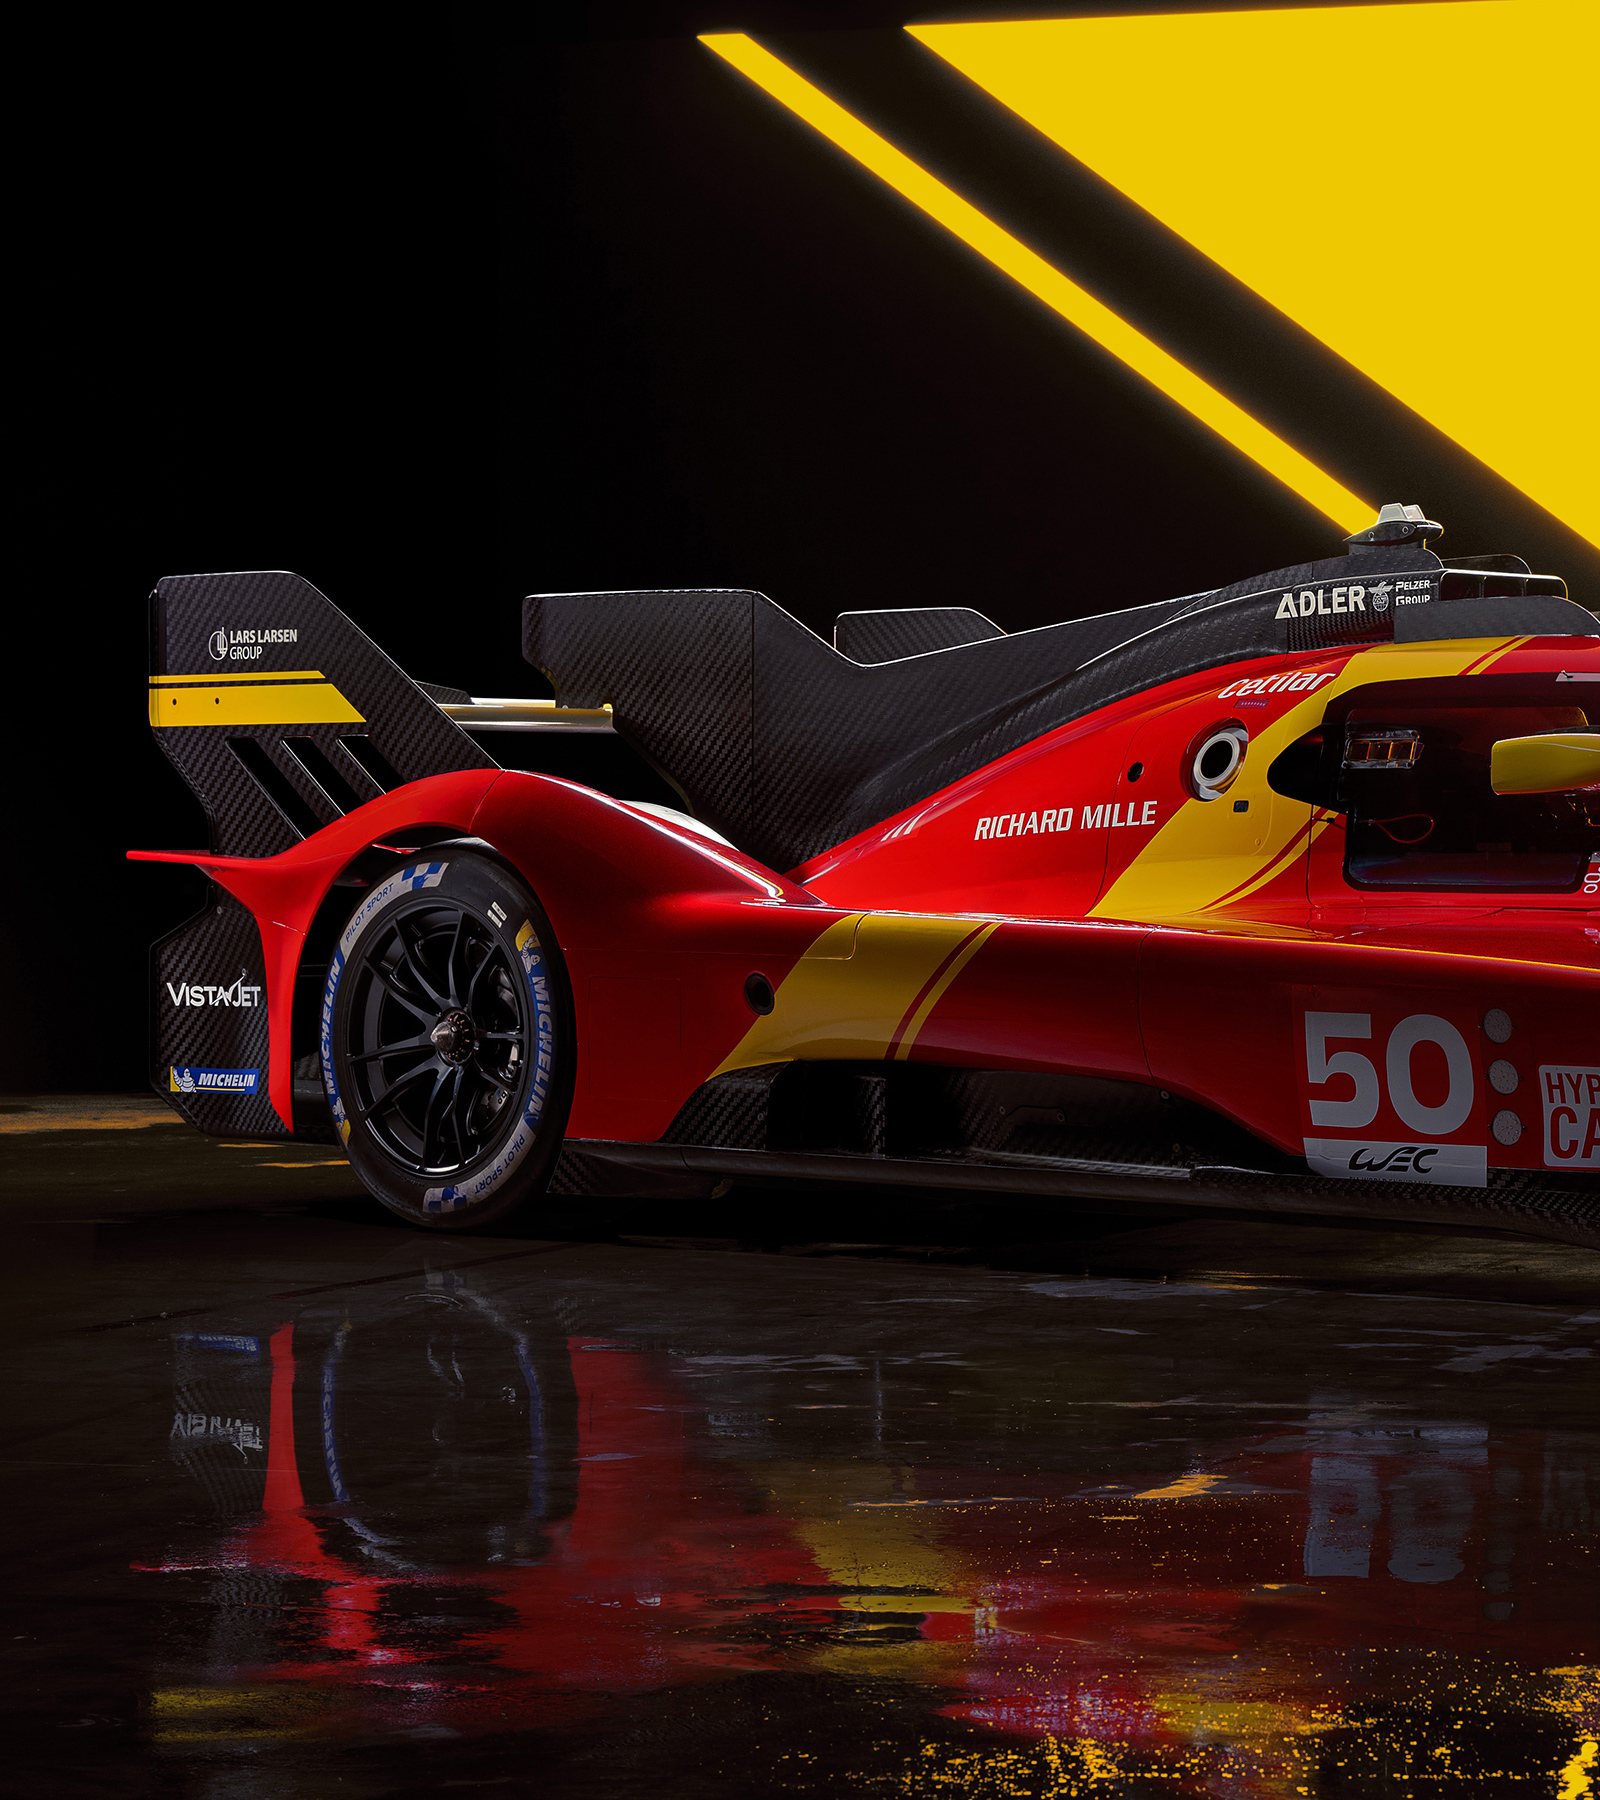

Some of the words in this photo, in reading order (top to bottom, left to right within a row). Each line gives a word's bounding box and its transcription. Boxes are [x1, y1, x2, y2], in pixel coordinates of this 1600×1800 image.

[1395, 580, 1430, 592] PELZER
[1395, 595, 1431, 606] GROUP
[1274, 585, 1366, 620] ADLER
[229, 630, 256, 644] LARS
[257, 629, 298, 643] LARSEN
[229, 646, 263, 660] GROUP
[974, 807, 1074, 841] RICHARD
[1080, 800, 1158, 830] MILLE
[345, 908, 365, 943] PILOT
[366, 882, 394, 913] SPORT
[321, 957, 341, 1095] MICHELIN
[528, 976, 553, 1121] MICHELIN
[198, 1073, 256, 1087] MICHELIN
[1305, 1011, 1474, 1135] 50
[505, 1133, 526, 1169] PILOT
[1348, 1146, 1439, 1174] WEC
[474, 1167, 504, 1195] SPORT
